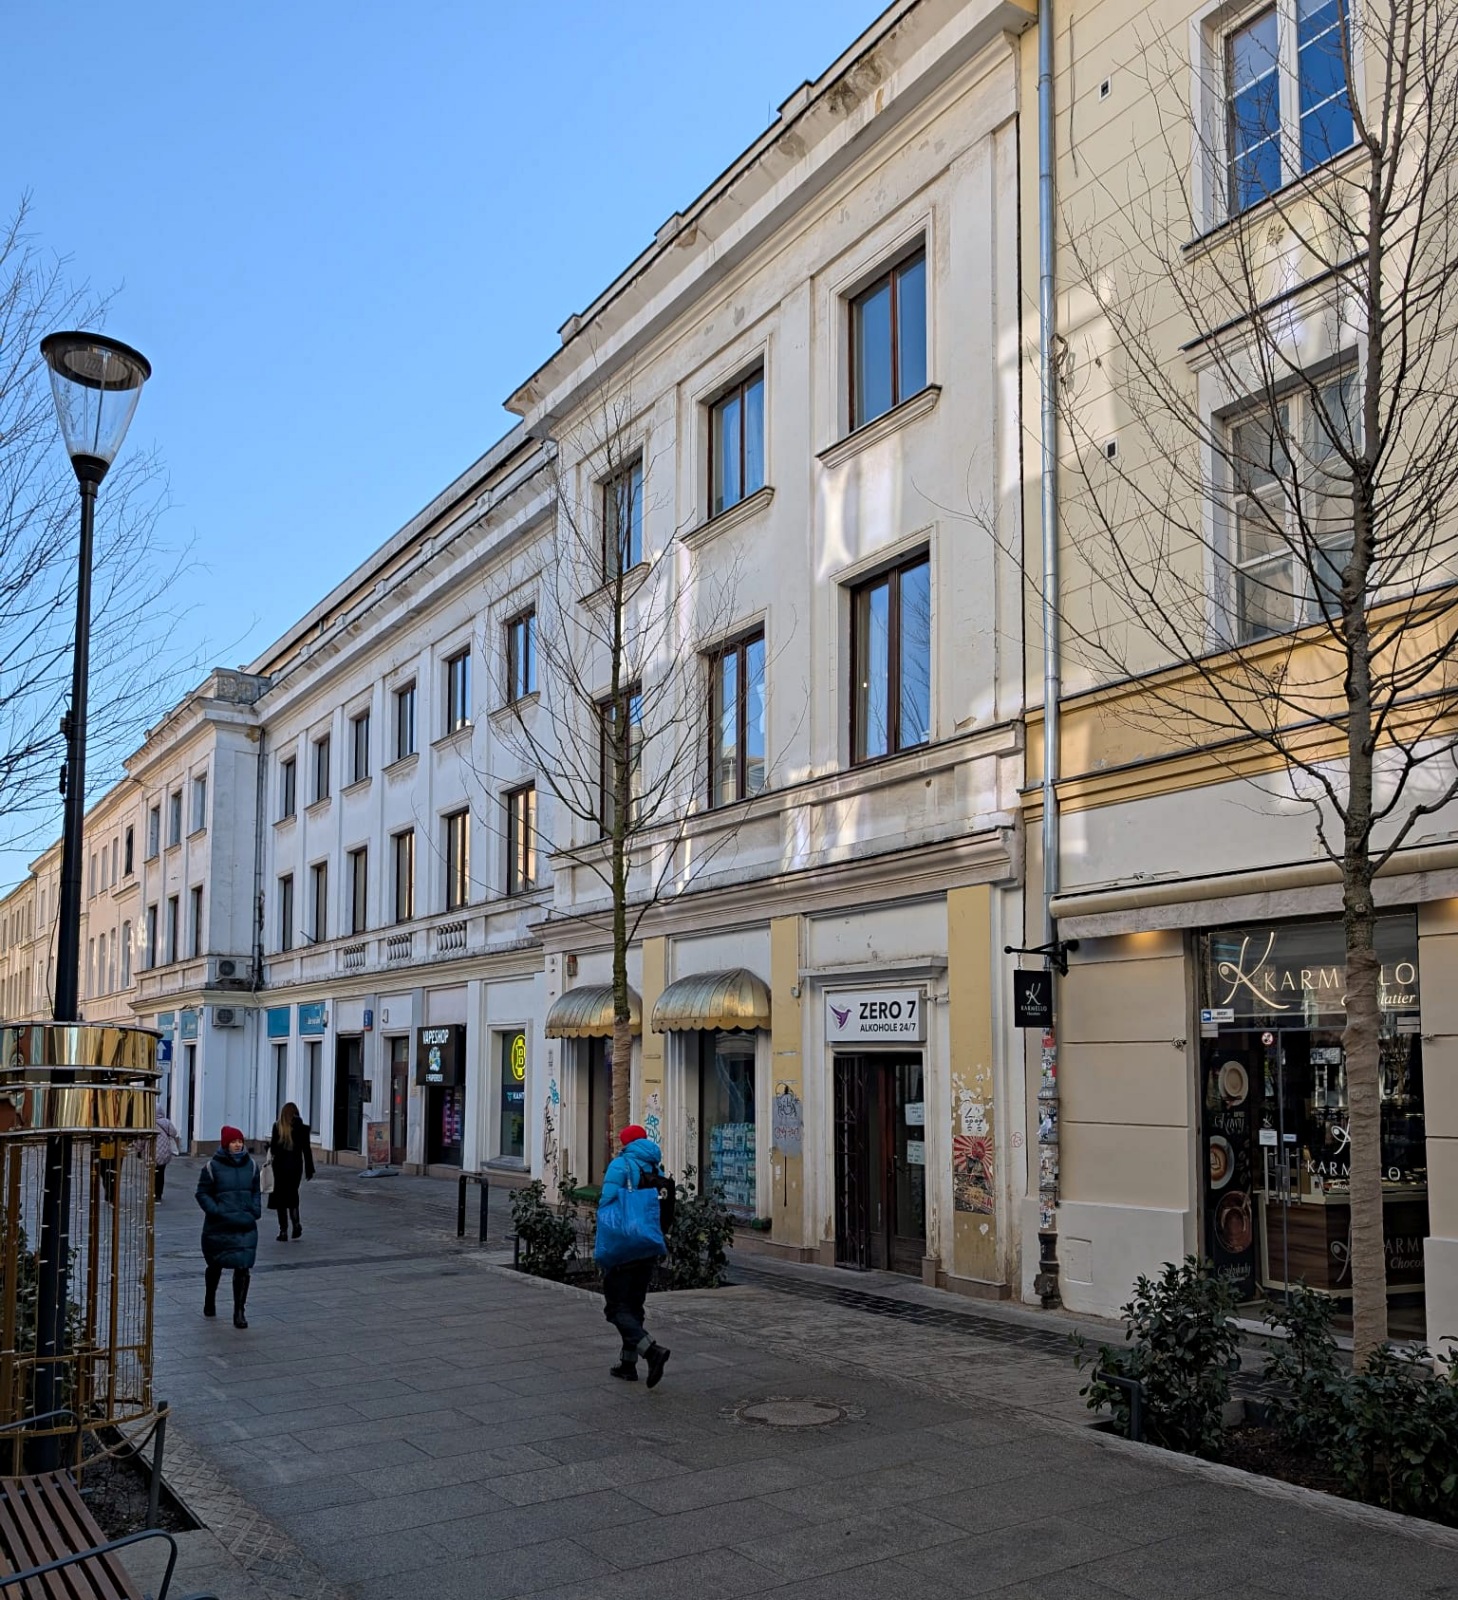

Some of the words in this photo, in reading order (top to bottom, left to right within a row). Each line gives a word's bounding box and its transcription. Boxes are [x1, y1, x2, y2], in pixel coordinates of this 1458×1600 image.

[1264, 962, 1415, 993] KARMLO
[859, 1001, 902, 1020] ZERO
[906, 1000, 917, 1019] 7
[1340, 993, 1416, 1007] Clatier
[860, 1023, 898, 1032] ALKOHOLE
[899, 1023, 916, 1032] 24/7
[1307, 1160, 1401, 1181] KARMO
